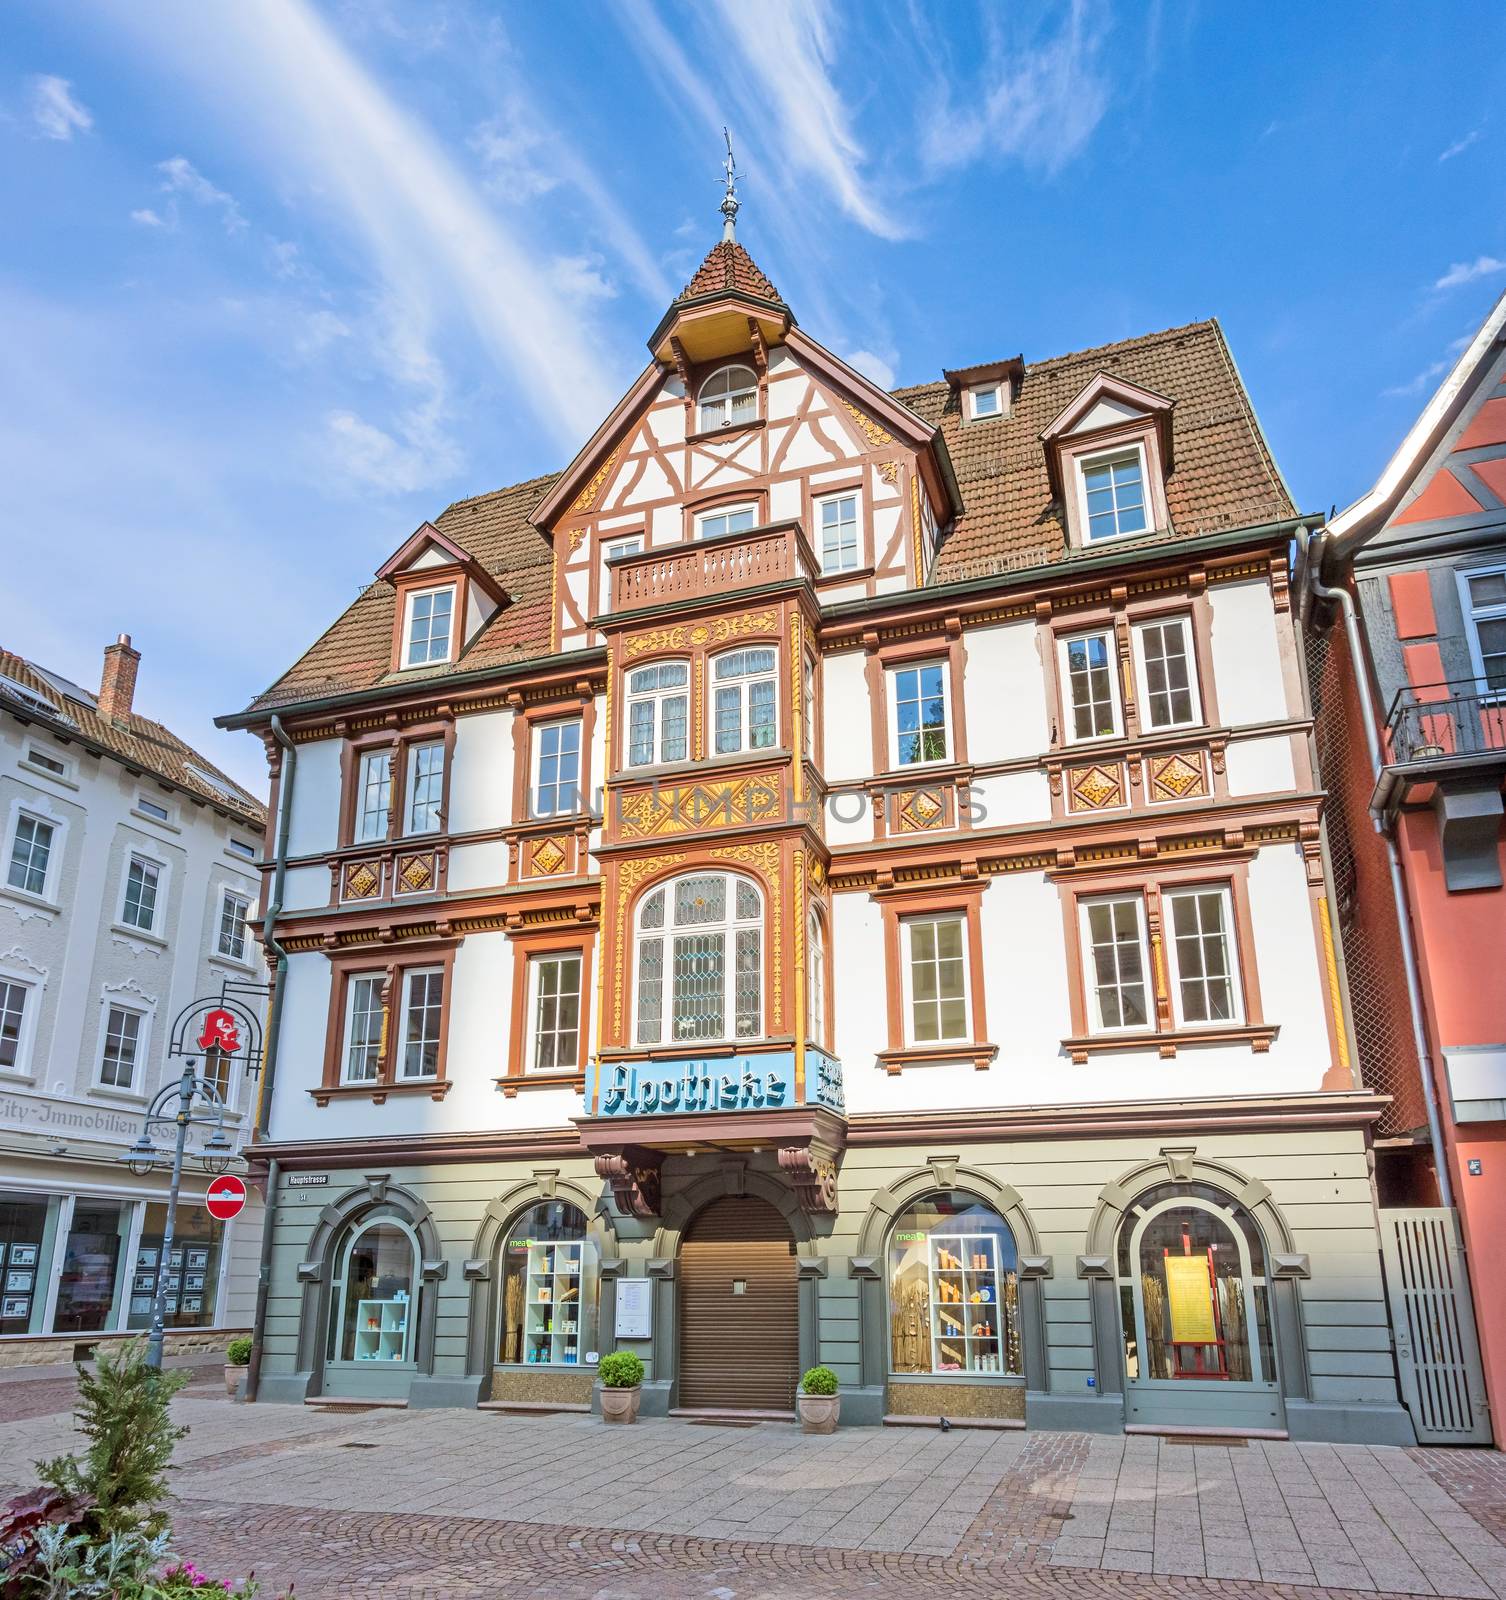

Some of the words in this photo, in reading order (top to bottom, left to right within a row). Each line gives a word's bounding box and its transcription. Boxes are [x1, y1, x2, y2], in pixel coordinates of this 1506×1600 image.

[604, 1059, 786, 1114] Apotheke
[148, 1122, 193, 1144] Bosh
[290, 1176, 326, 1184] Hauptstrasse
